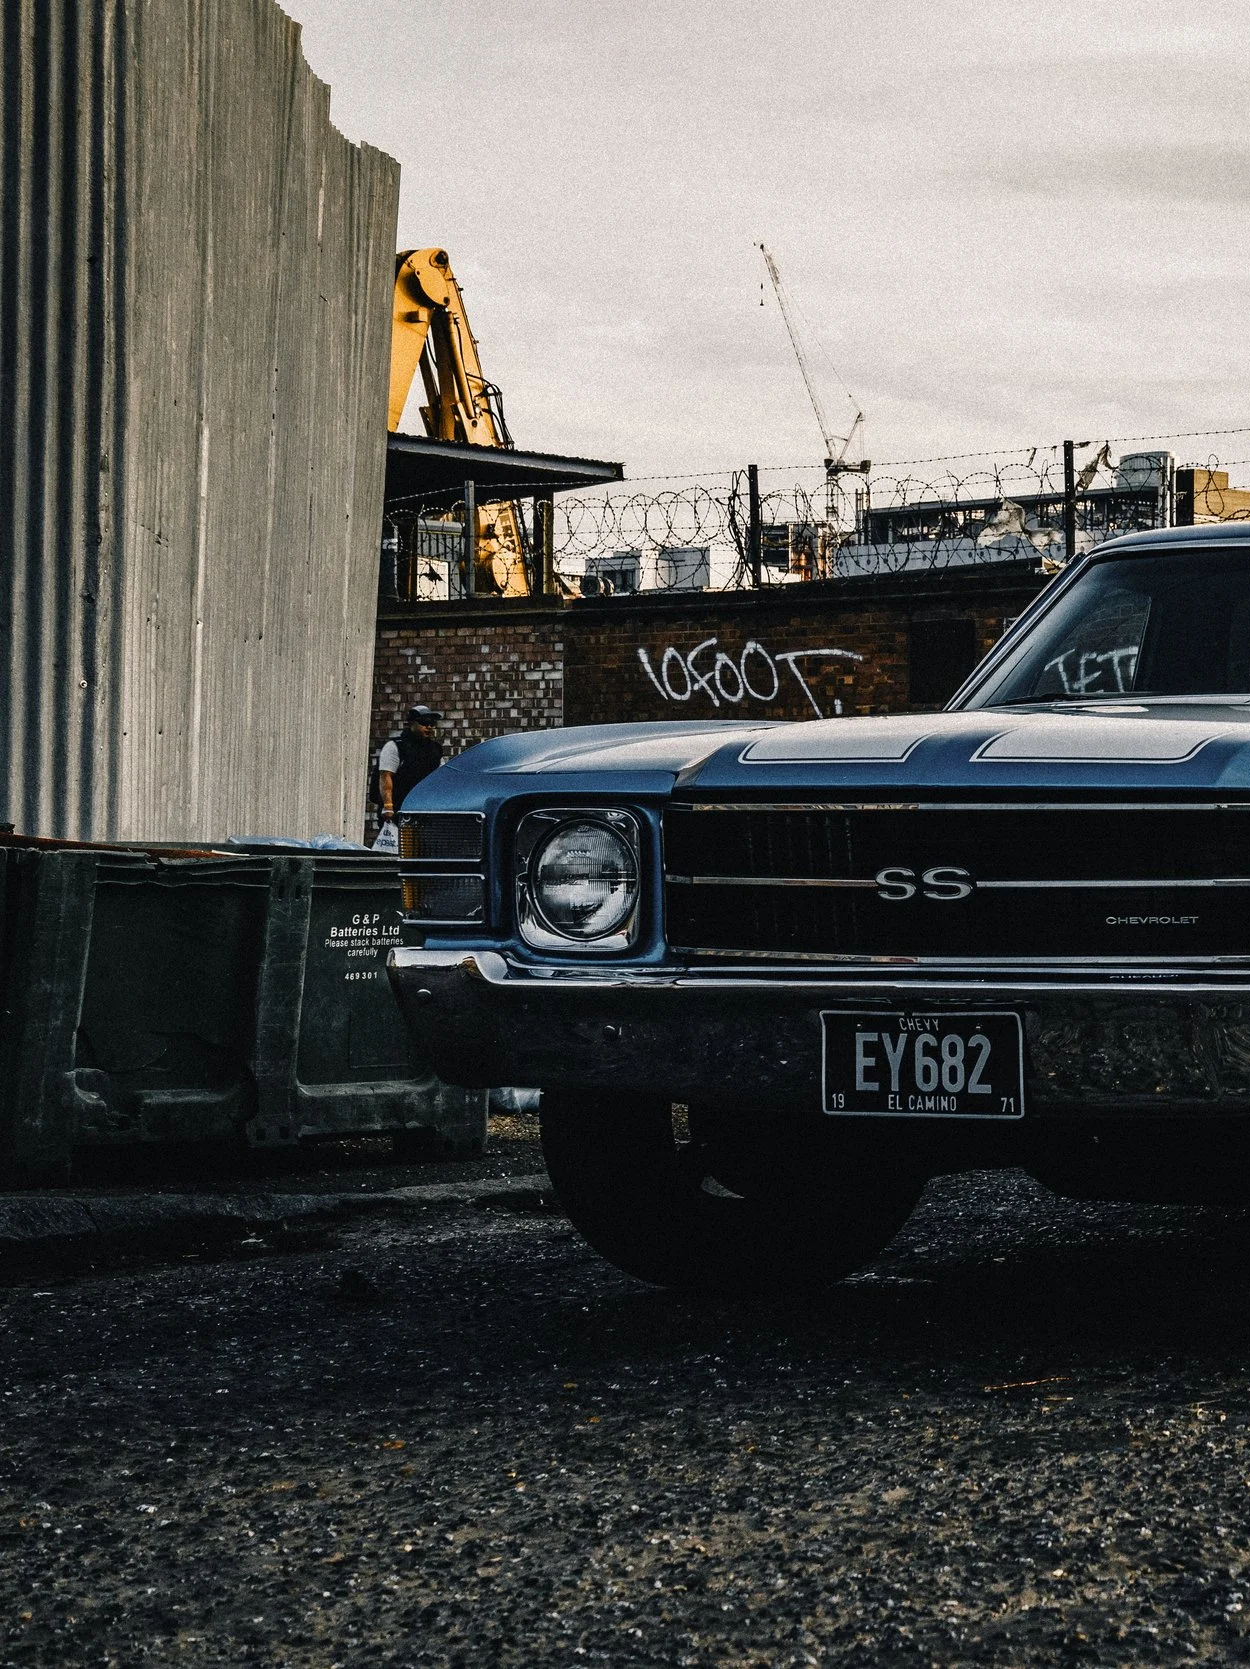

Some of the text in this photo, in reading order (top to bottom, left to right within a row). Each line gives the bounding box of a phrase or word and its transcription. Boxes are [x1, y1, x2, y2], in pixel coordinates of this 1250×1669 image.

[875, 866, 973, 900] SS
[352, 914, 380, 925] G & P
[1105, 916, 1199, 925] CHEVROLET
[330, 925, 400, 938] Batteries Ltd
[325, 936, 404, 948] Please stack batteries
[347, 947, 378, 958] carefully
[899, 1017, 939, 1031] CHEVY
[855, 1032, 992, 1094] EY682
[831, 1093, 1014, 1113] 19 EL CAMINO 71
